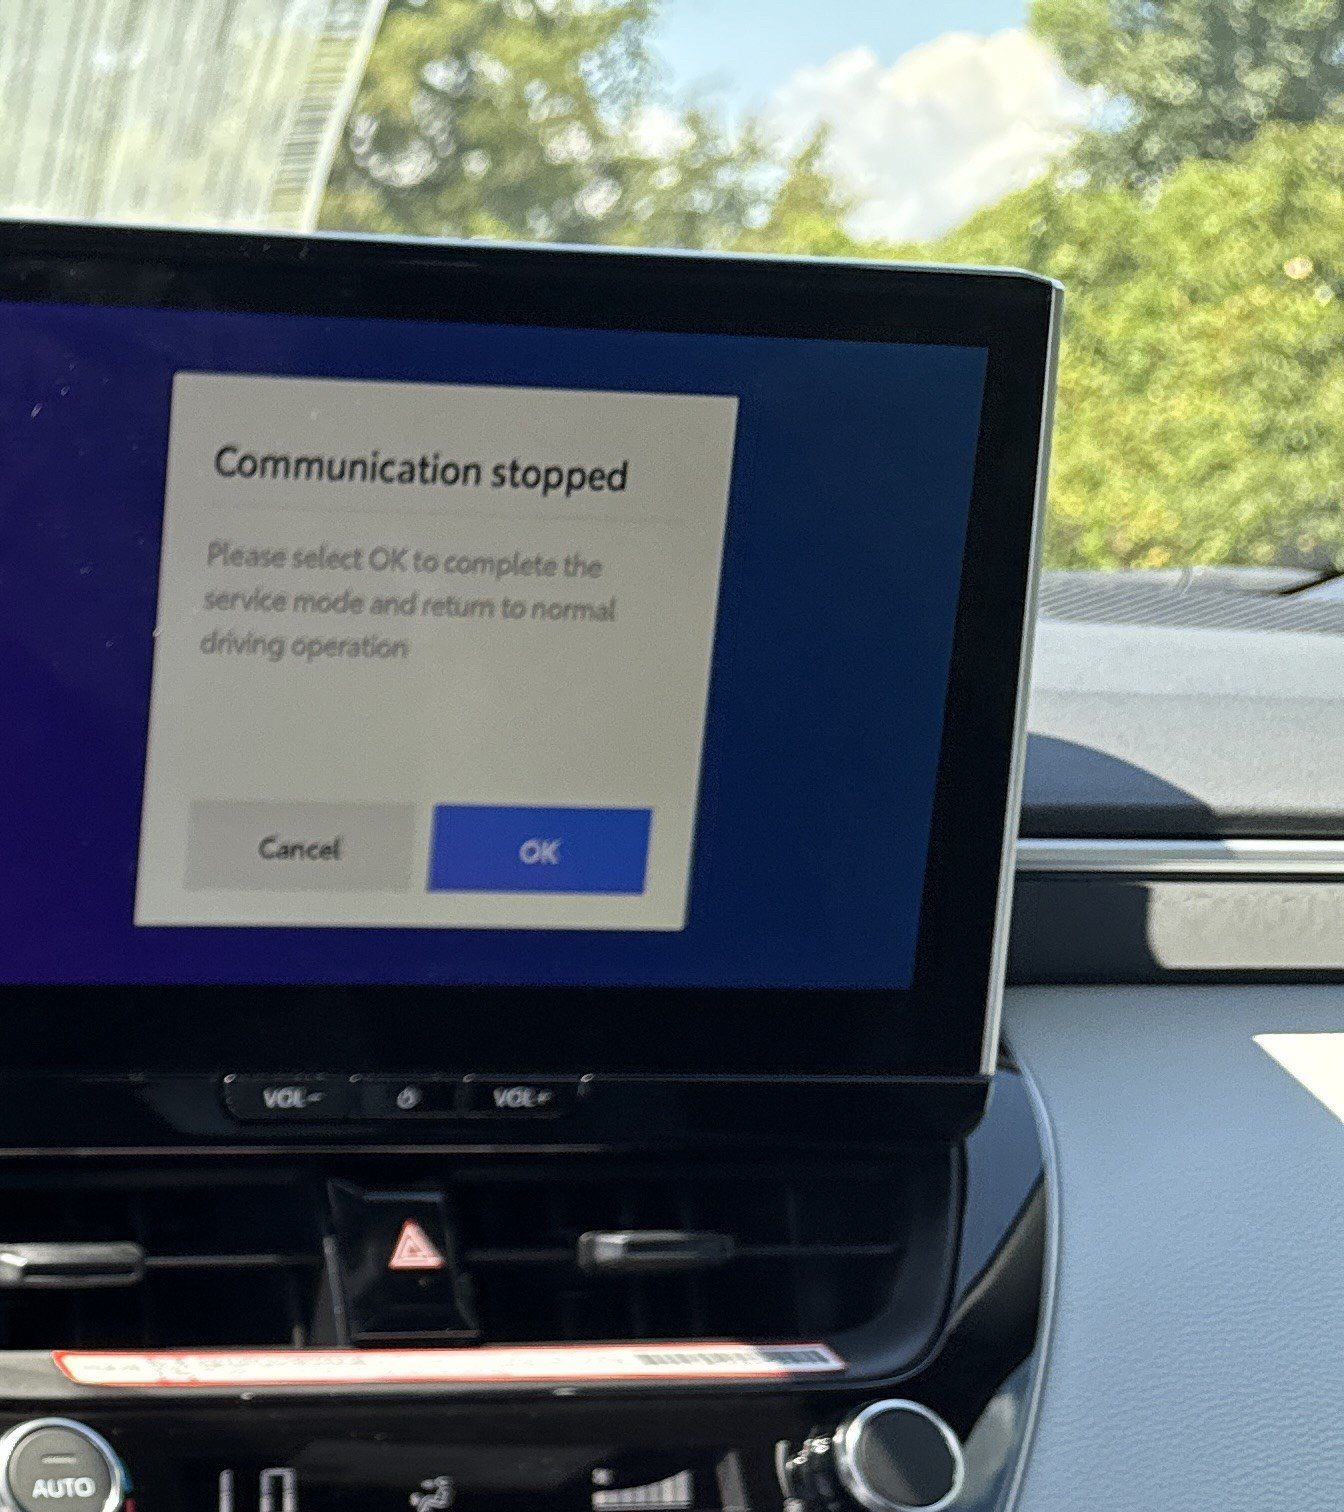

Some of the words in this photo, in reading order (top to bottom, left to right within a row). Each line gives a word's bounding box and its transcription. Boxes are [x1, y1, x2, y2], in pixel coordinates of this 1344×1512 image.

[214, 445, 482, 488] Communication
[490, 459, 629, 499] stopped
[206, 540, 288, 570] Please
[292, 543, 364, 573] select
[368, 545, 410, 574] OK
[413, 550, 440, 575] to
[443, 550, 558, 582] complete
[562, 552, 603, 580] the
[203, 584, 288, 613] service
[292, 588, 364, 616] mode
[369, 591, 416, 617] and
[419, 596, 496, 621] return
[500, 597, 527, 622] to
[530, 596, 617, 623] normal
[199, 630, 286, 663] driving
[290, 632, 410, 663] operation
[258, 834, 342, 863] Cancel
[519, 839, 562, 866] OK
[31, 1475, 96, 1499] AUTO
